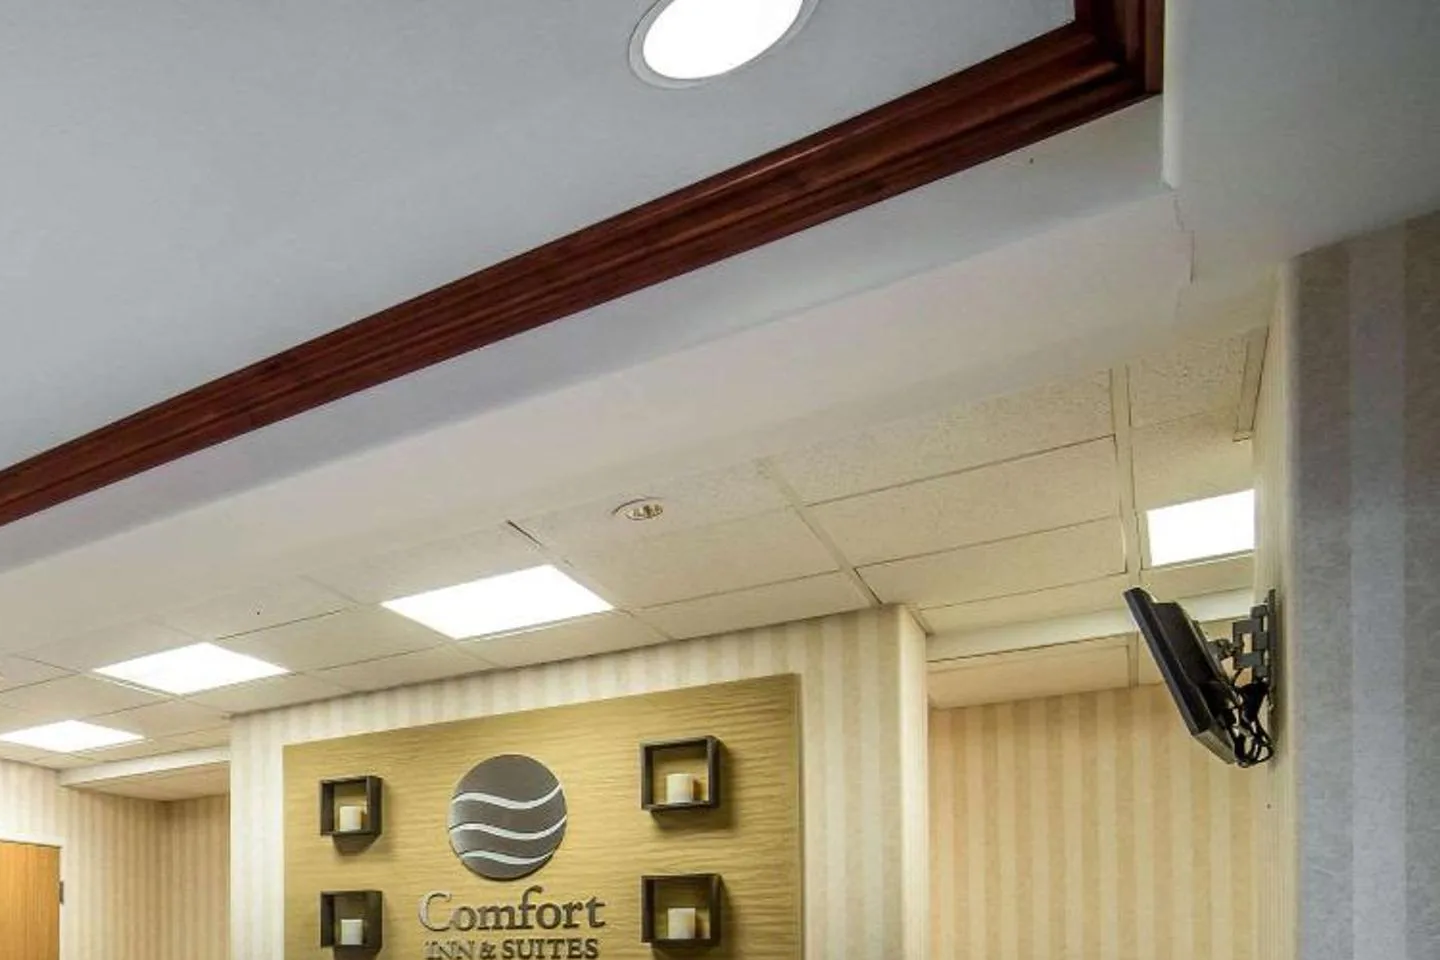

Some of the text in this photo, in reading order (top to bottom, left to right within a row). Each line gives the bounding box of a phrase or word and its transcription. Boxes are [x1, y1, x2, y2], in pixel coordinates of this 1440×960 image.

[418, 885, 606, 932] Comfort
[425, 938, 598, 960] INN & SUITES
